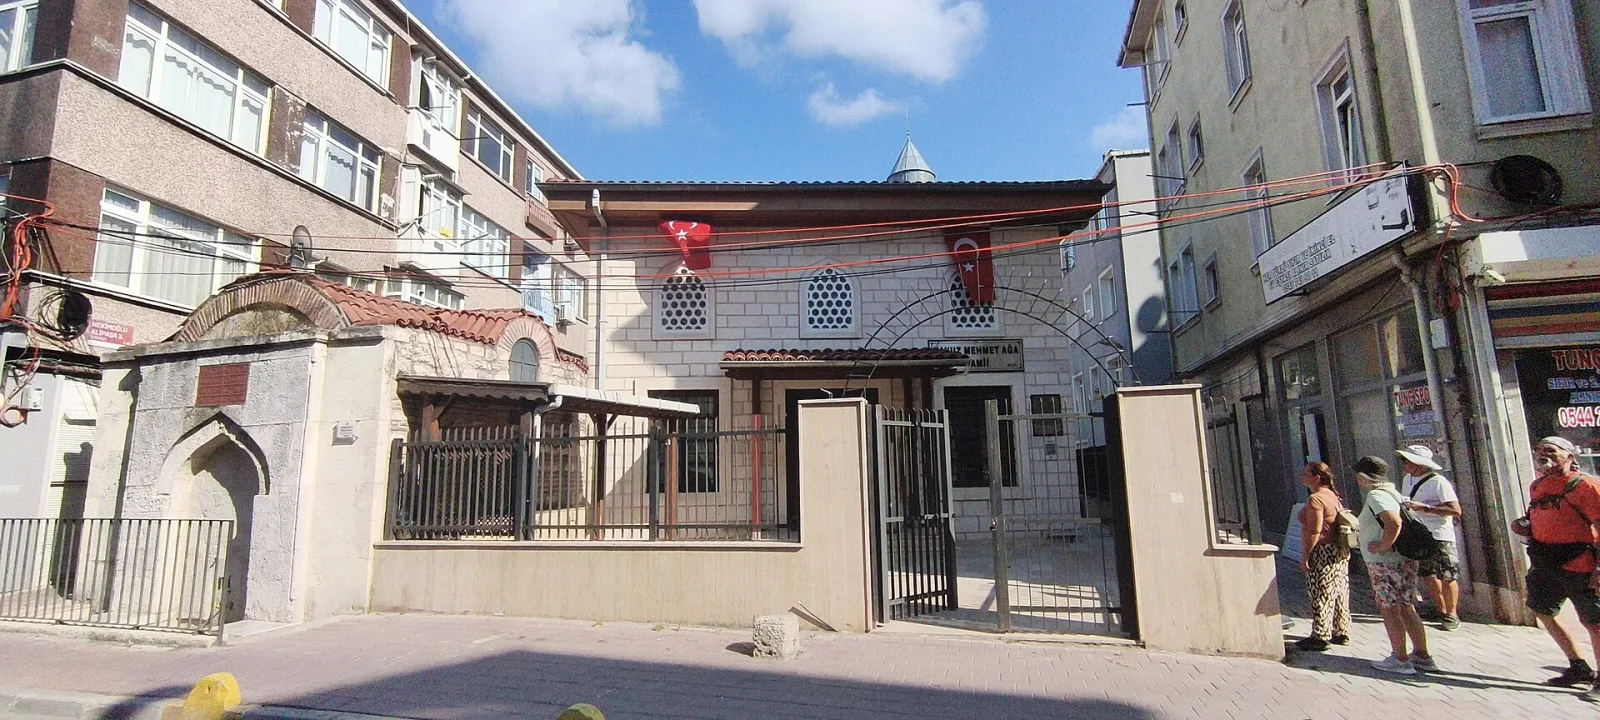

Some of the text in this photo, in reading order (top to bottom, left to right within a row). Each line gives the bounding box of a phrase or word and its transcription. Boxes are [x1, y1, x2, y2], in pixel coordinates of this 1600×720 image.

[964, 345, 1000, 354] MEHMET
[1001, 343, 1019, 354] AĞA
[967, 357, 989, 367] AMİİ
[1414, 387, 1432, 406] SPO
[1558, 405, 1596, 428] 0544
